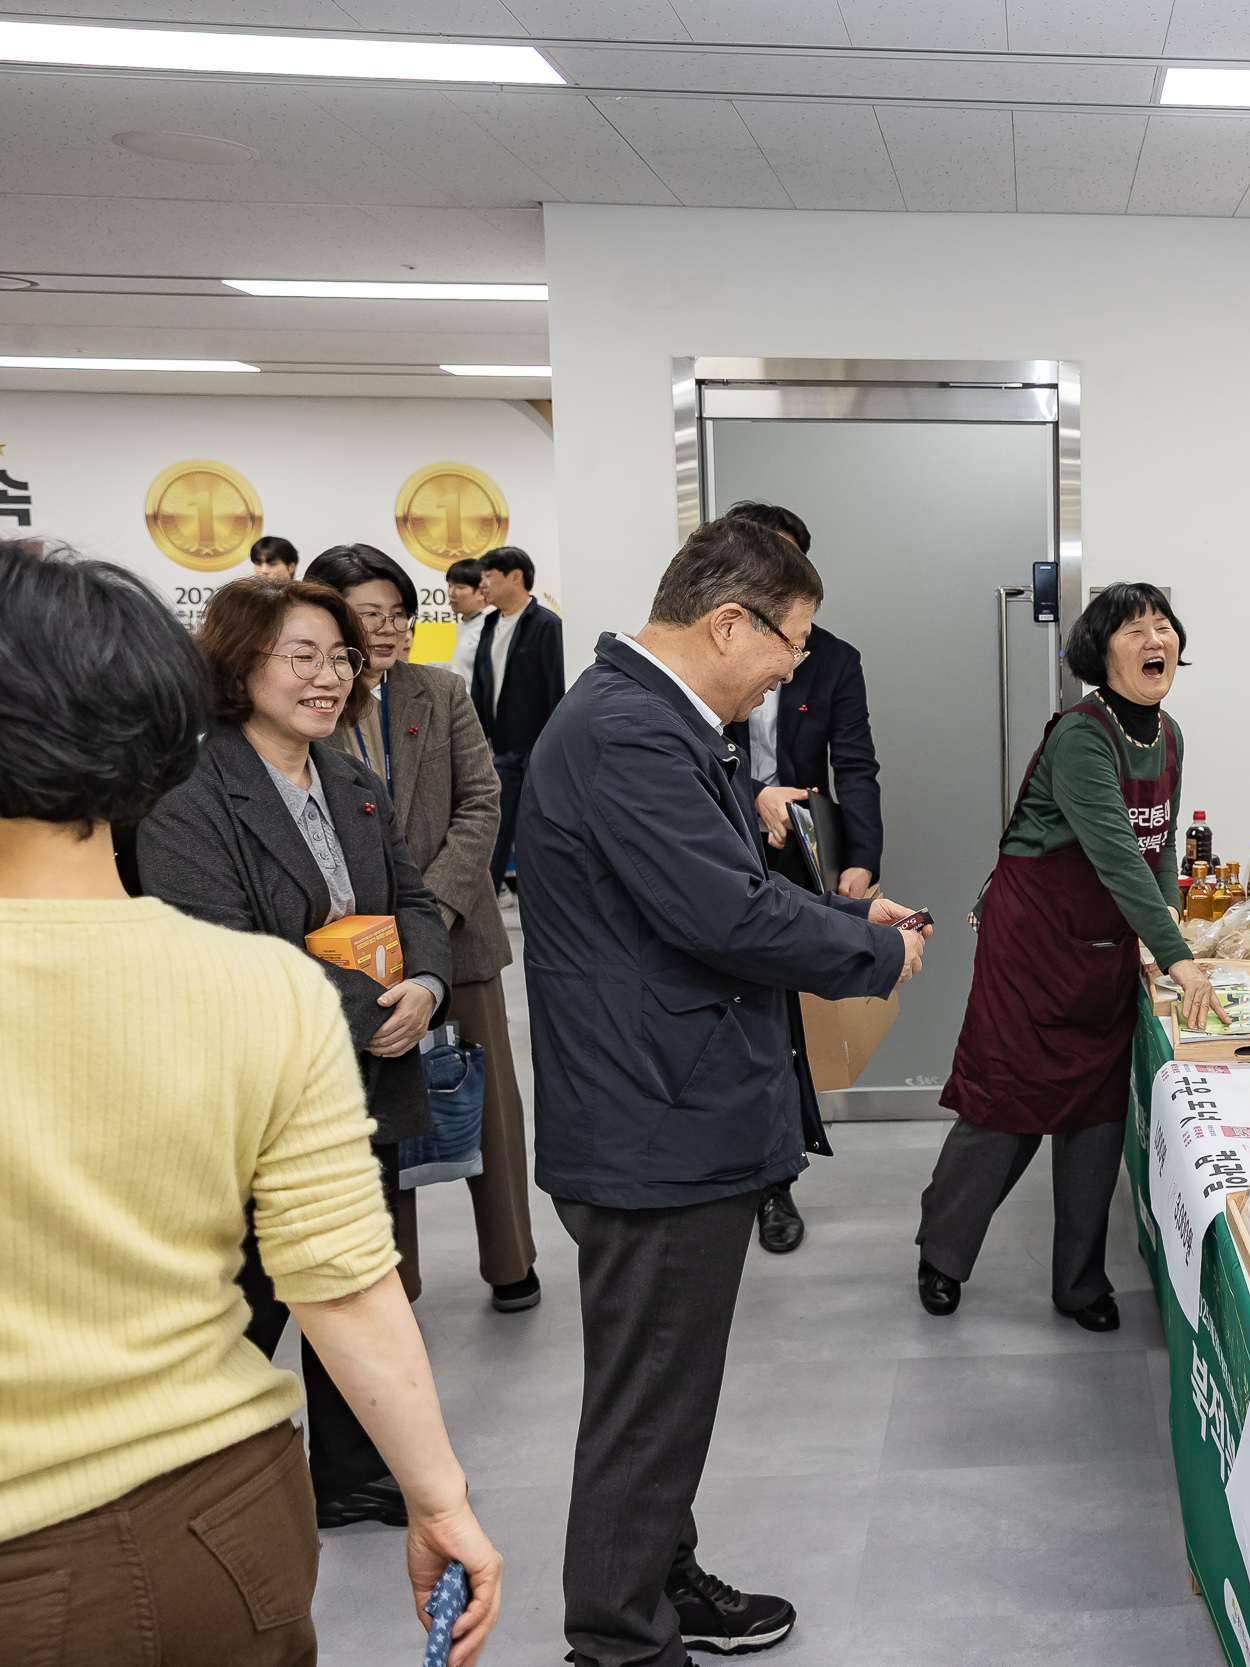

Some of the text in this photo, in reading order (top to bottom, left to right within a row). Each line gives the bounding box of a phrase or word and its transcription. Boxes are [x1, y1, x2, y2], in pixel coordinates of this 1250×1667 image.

[1171, 1077, 1222, 1128] 구운 도넛
[1194, 1150, 1250, 1199] 컵과일
